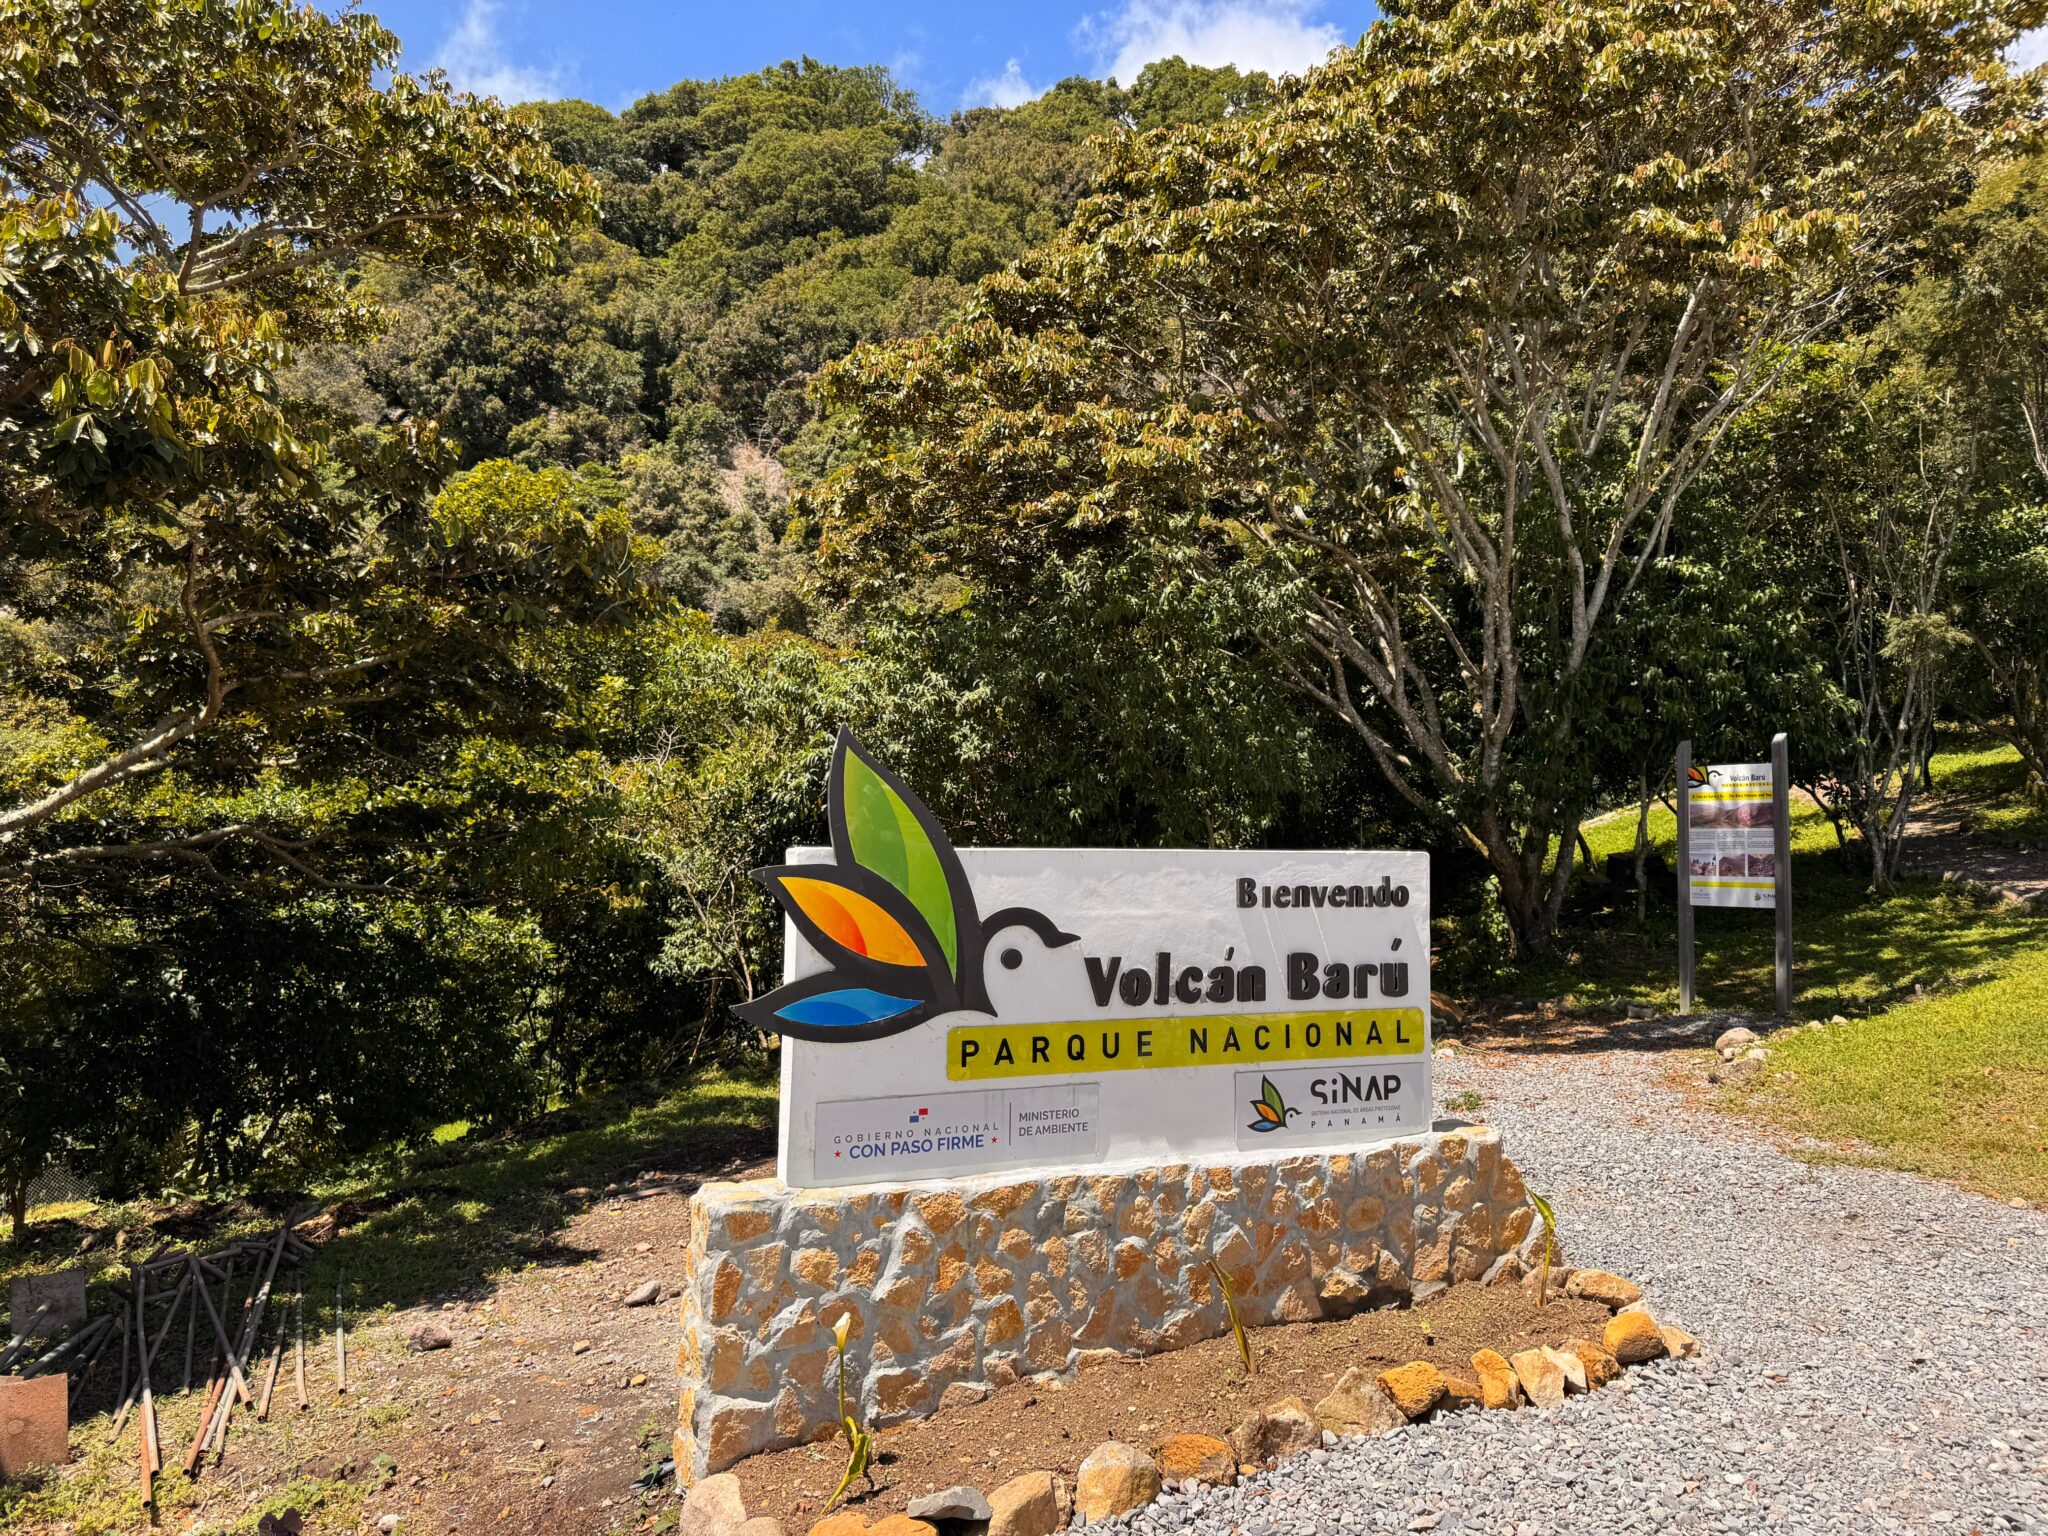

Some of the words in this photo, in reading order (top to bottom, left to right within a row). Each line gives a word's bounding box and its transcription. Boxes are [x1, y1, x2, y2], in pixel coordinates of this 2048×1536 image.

[1236, 876, 1410, 908] Bienvenido
[1084, 946, 1267, 1007] Volcán
[1287, 938, 1409, 1001] Barú
[961, 1030, 1153, 1067] PARQUE
[1190, 1019, 1410, 1053] NACIONAL
[1019, 1108, 1080, 1122] MINISTERIO
[1310, 1109, 1330, 1117] SISTEMA
[1330, 1107, 1352, 1115] NACIONAL
[1374, 1104, 1401, 1112] PROTEGIDAS
[1310, 1112, 1401, 1129] PANAMÁ
[834, 1129, 914, 1144] GOBIERNO
[924, 1122, 999, 1136] NACIONAL
[1019, 1126, 1033, 1137] DE
[1034, 1122, 1089, 1136] AMBIENTE
[849, 1142, 886, 1159] CON
[891, 1139, 933, 1155] PASO
[937, 1134, 985, 1151] FIRME
